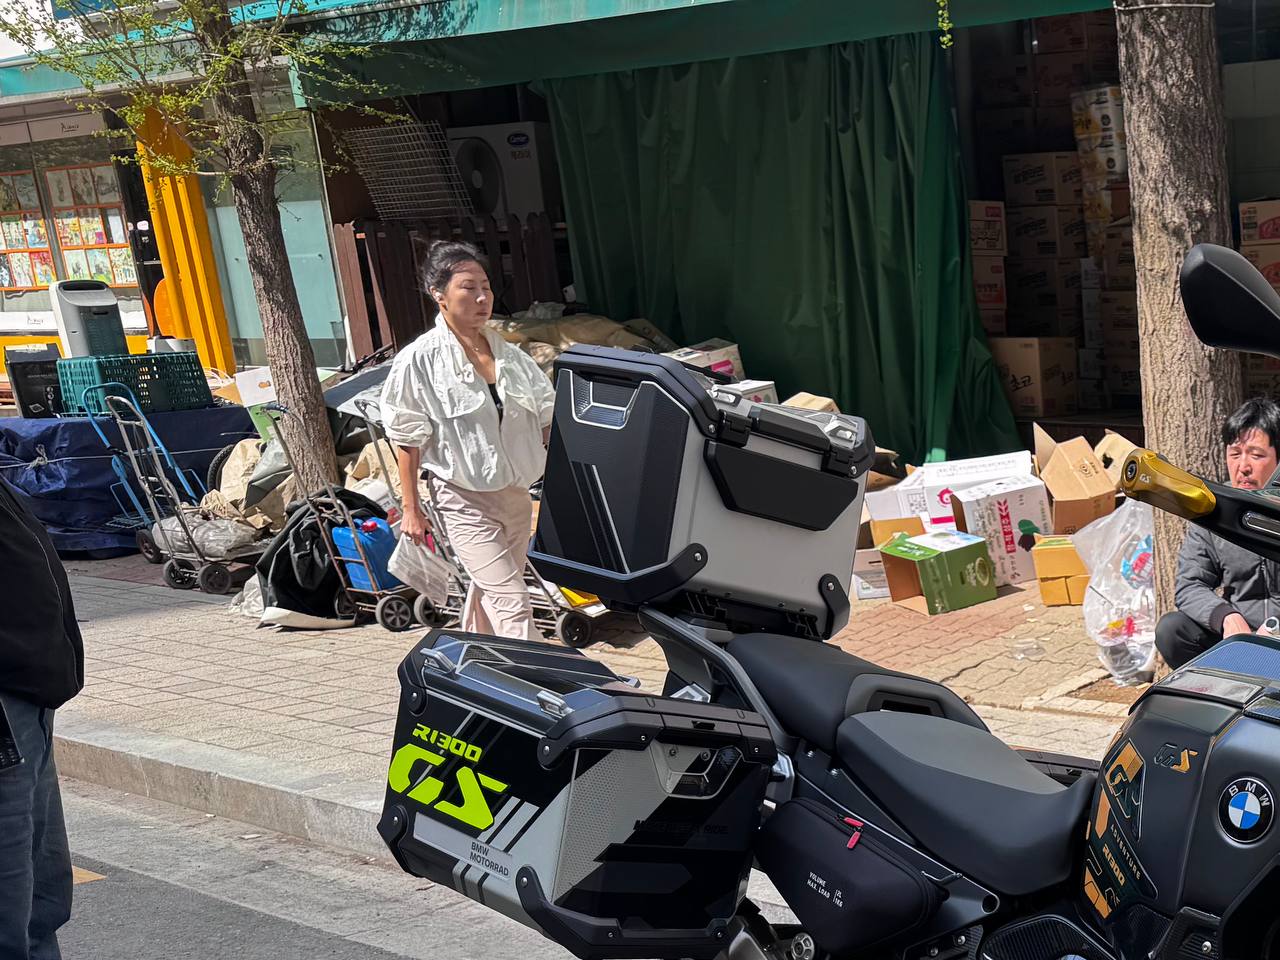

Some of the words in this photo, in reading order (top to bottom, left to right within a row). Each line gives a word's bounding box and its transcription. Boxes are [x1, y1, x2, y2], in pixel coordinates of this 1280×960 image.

[413, 723, 482, 762] R1300
[1154, 743, 1199, 774] GS
[389, 743, 509, 830] GS
[1229, 782, 1271, 807] BMW
[470, 851, 509, 876] MOTORRAD
[471, 841, 490, 857] BMW
[1103, 843, 1126, 887] R1300
[1110, 823, 1142, 881] ADVENTURE
